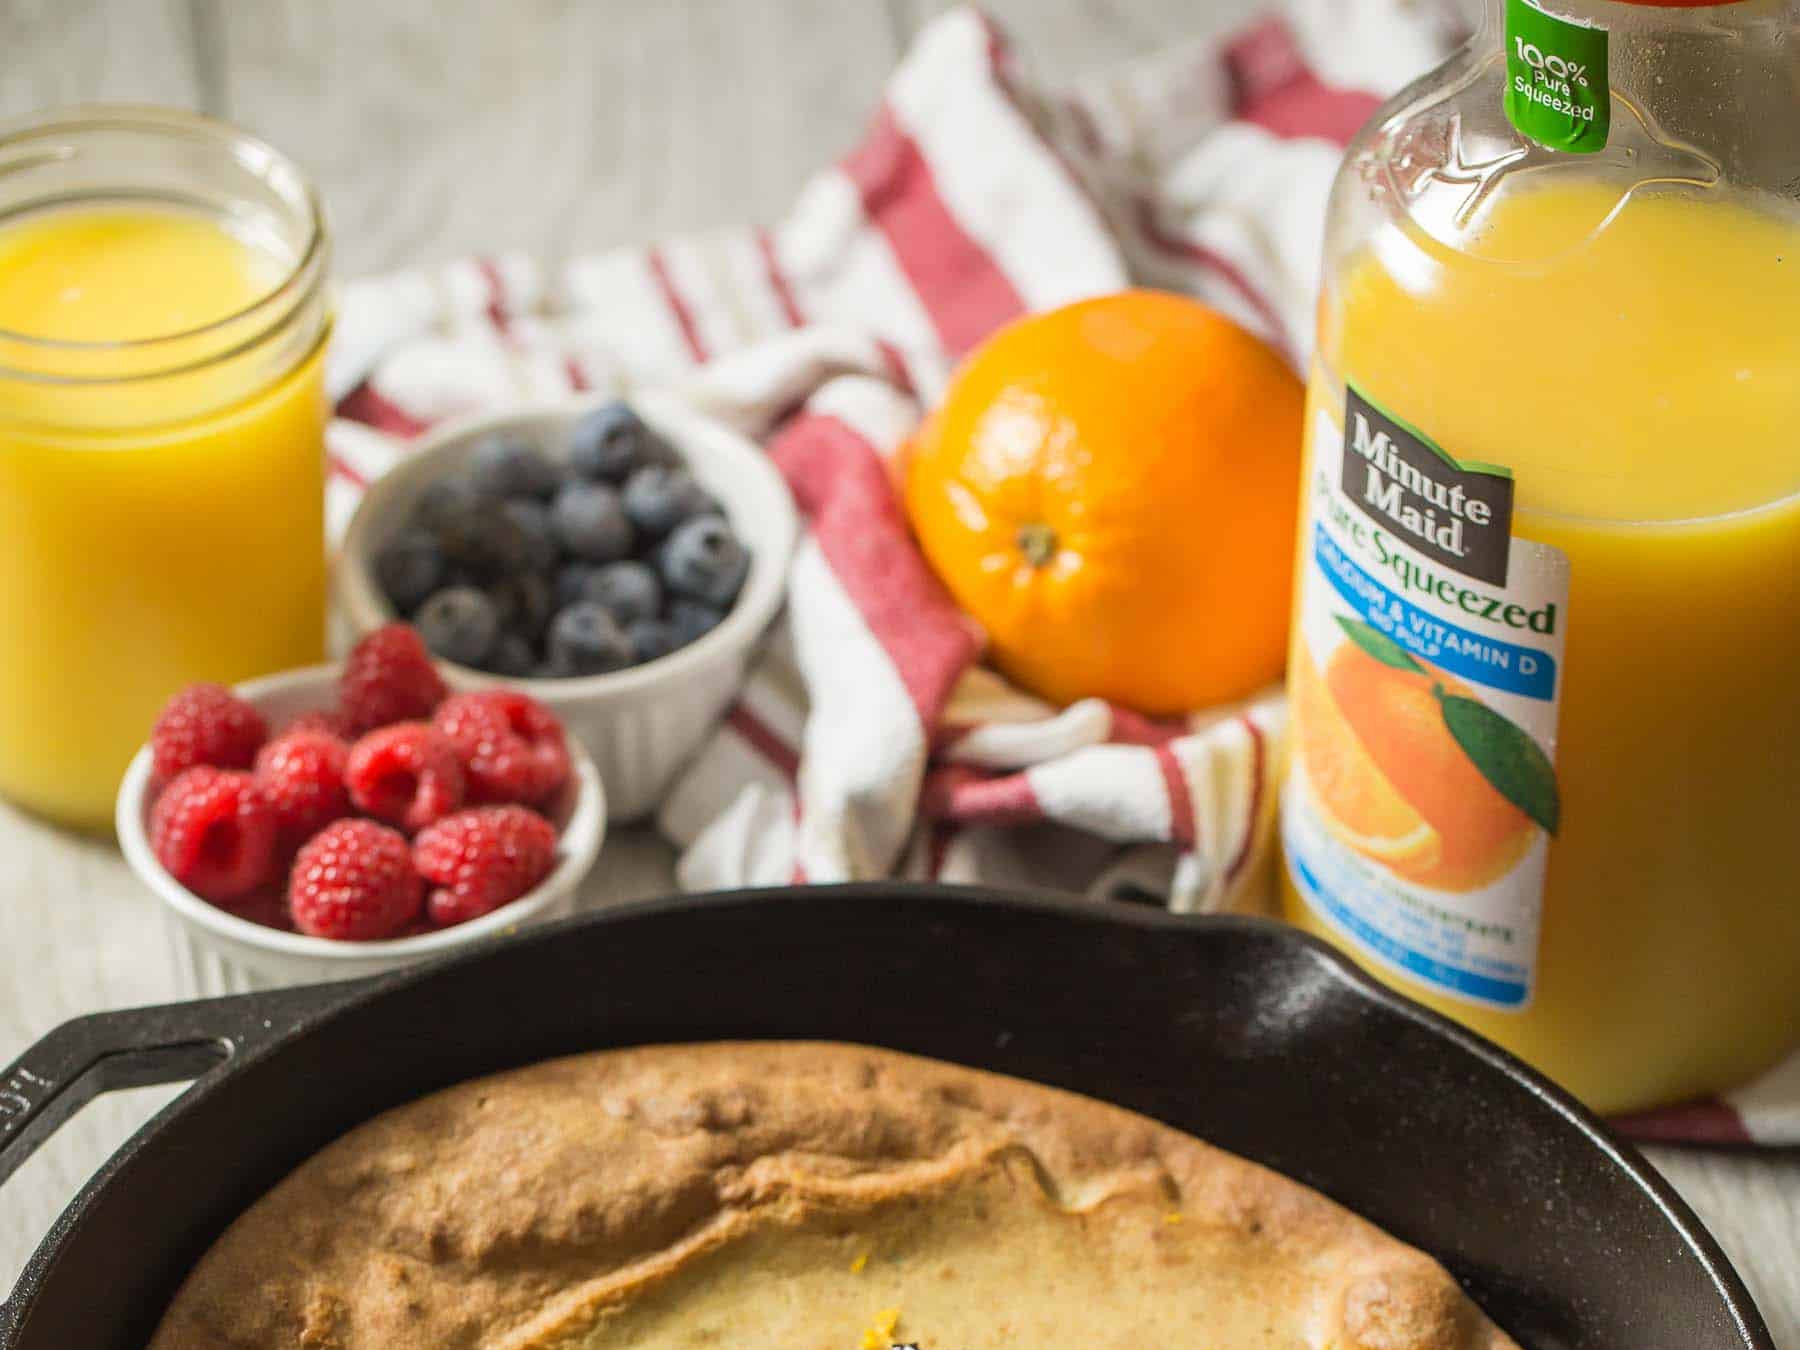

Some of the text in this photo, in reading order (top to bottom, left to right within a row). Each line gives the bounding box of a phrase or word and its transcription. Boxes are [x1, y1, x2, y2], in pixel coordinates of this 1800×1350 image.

[1515, 35, 1588, 87] 100%
[1534, 69, 1571, 97] Pure
[1515, 76, 1594, 121] Squeezed
[1352, 412, 1492, 525] Minute
[1365, 463, 1465, 557] Maid
[1372, 530, 1556, 635] Squeezed
[1410, 612, 1510, 669] VITAMIN
[1519, 656, 1537, 675] D
